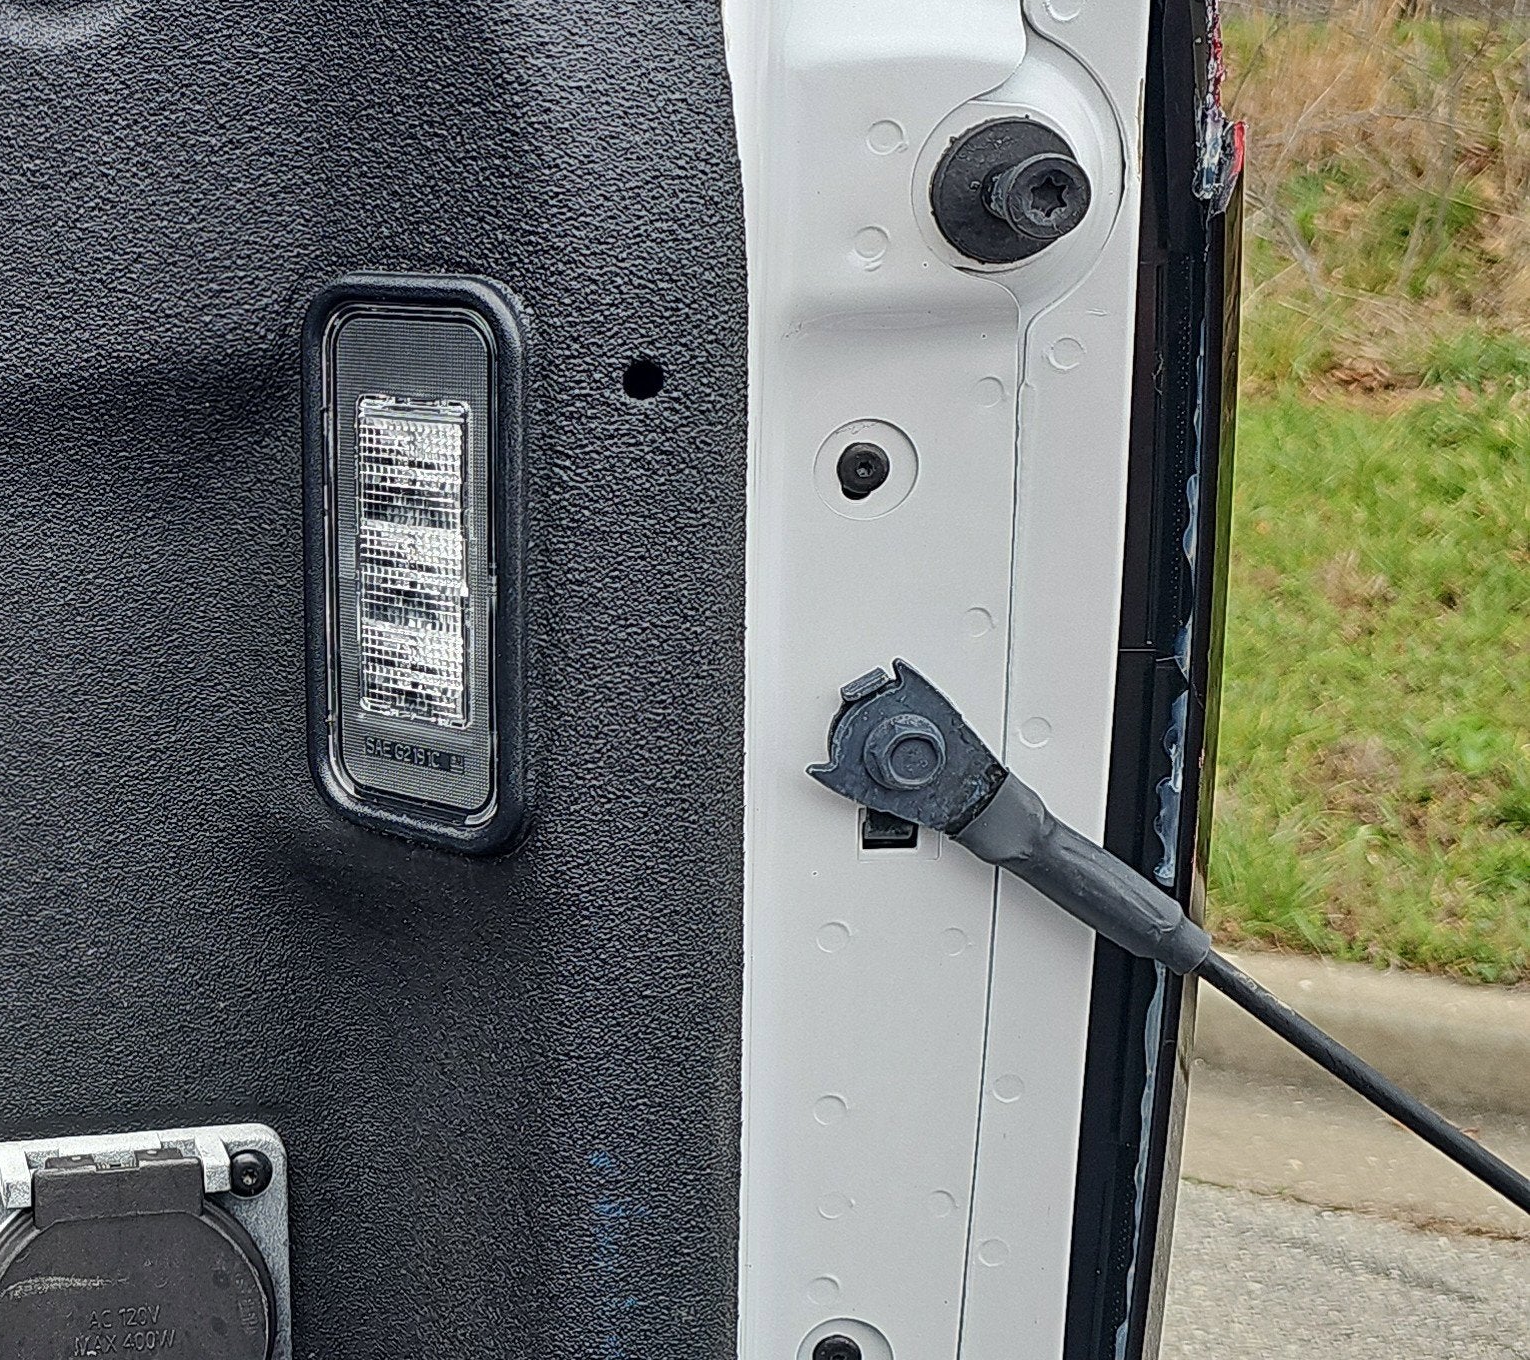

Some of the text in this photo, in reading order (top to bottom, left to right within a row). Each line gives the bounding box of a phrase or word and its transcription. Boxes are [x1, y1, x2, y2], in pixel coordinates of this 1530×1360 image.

[365, 736, 392, 758] SAE
[88, 1309, 112, 1329] AC
[73, 1327, 176, 1357] MAX 400W
